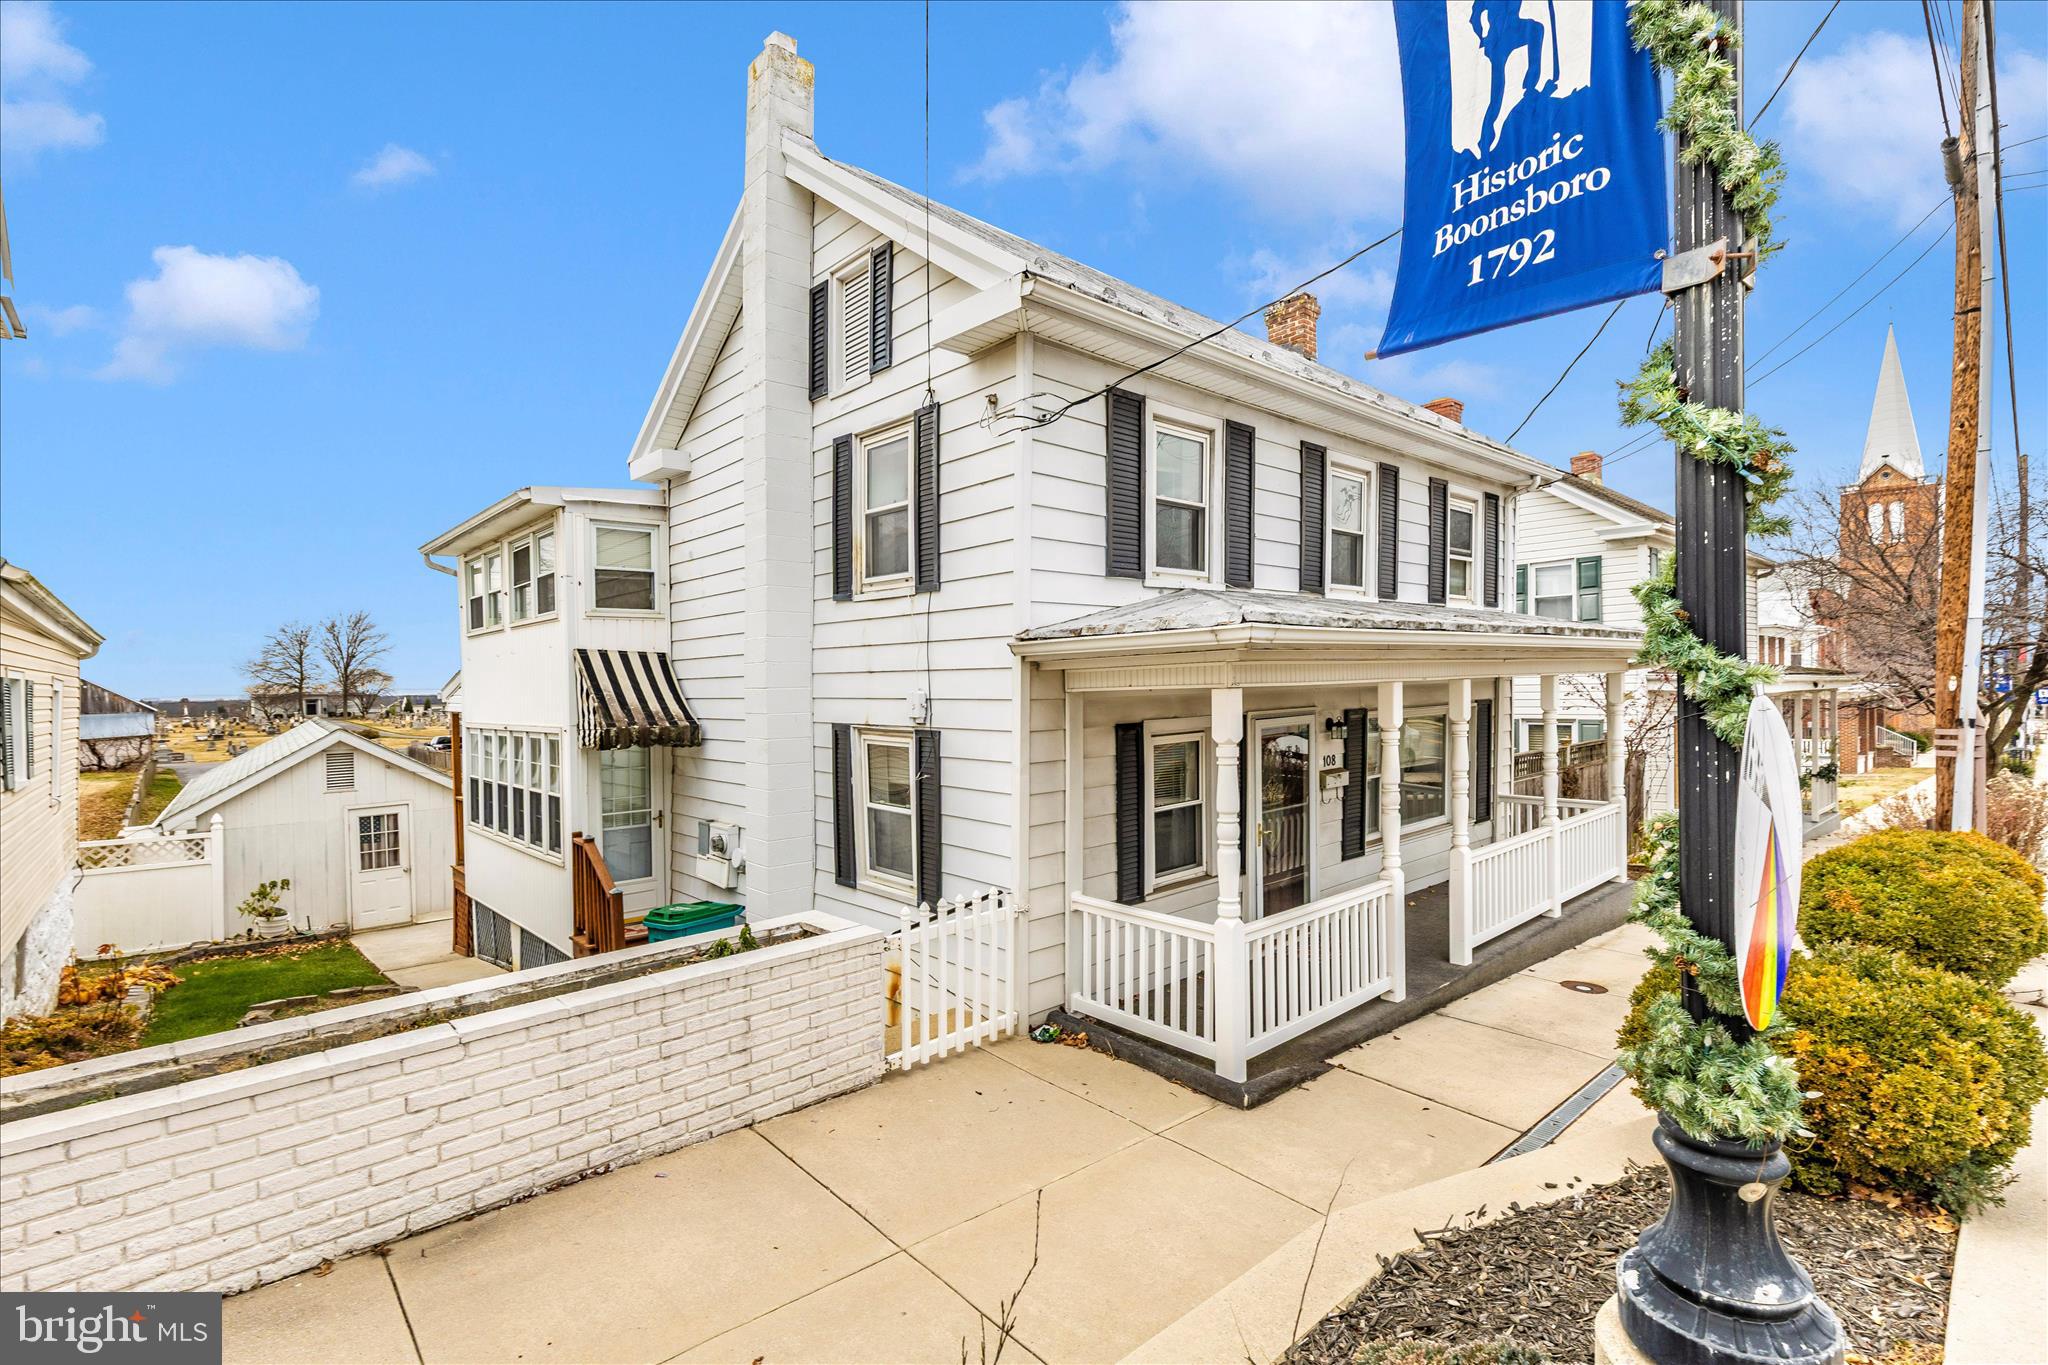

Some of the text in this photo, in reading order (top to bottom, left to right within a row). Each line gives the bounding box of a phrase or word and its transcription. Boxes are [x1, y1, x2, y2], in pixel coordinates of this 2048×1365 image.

[1452, 132, 1584, 213] Historic
[1432, 167, 1611, 258] Boonsboro
[1467, 229, 1556, 287] 1792
[1322, 754, 1337, 768] 108
